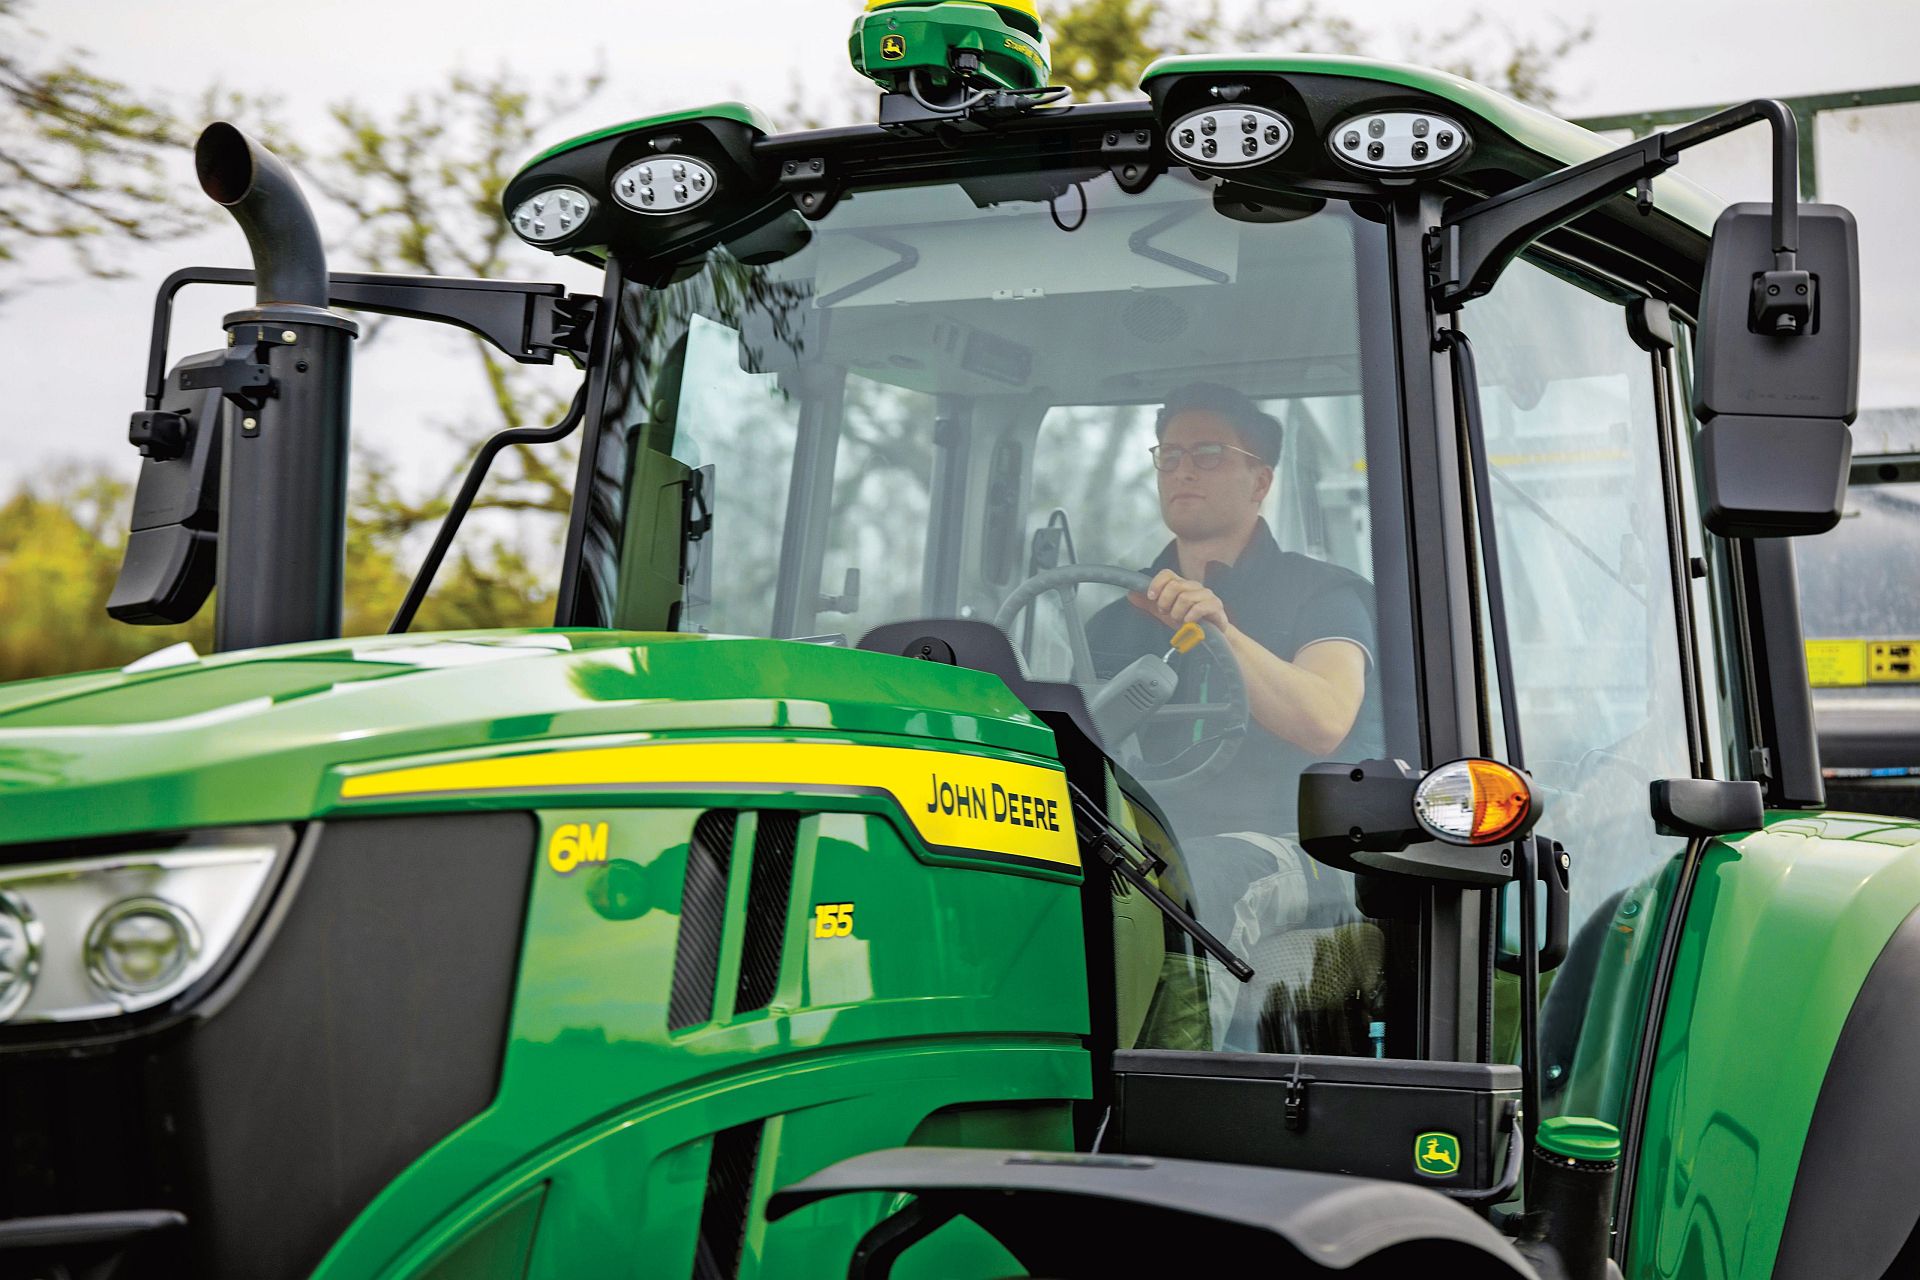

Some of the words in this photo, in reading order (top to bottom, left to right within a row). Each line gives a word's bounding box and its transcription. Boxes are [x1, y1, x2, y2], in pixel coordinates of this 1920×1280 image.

[927, 773, 987, 820] JOHN
[991, 782, 1060, 832] DEERE
[548, 821, 609, 873] 6M
[815, 903, 855, 938] 155
